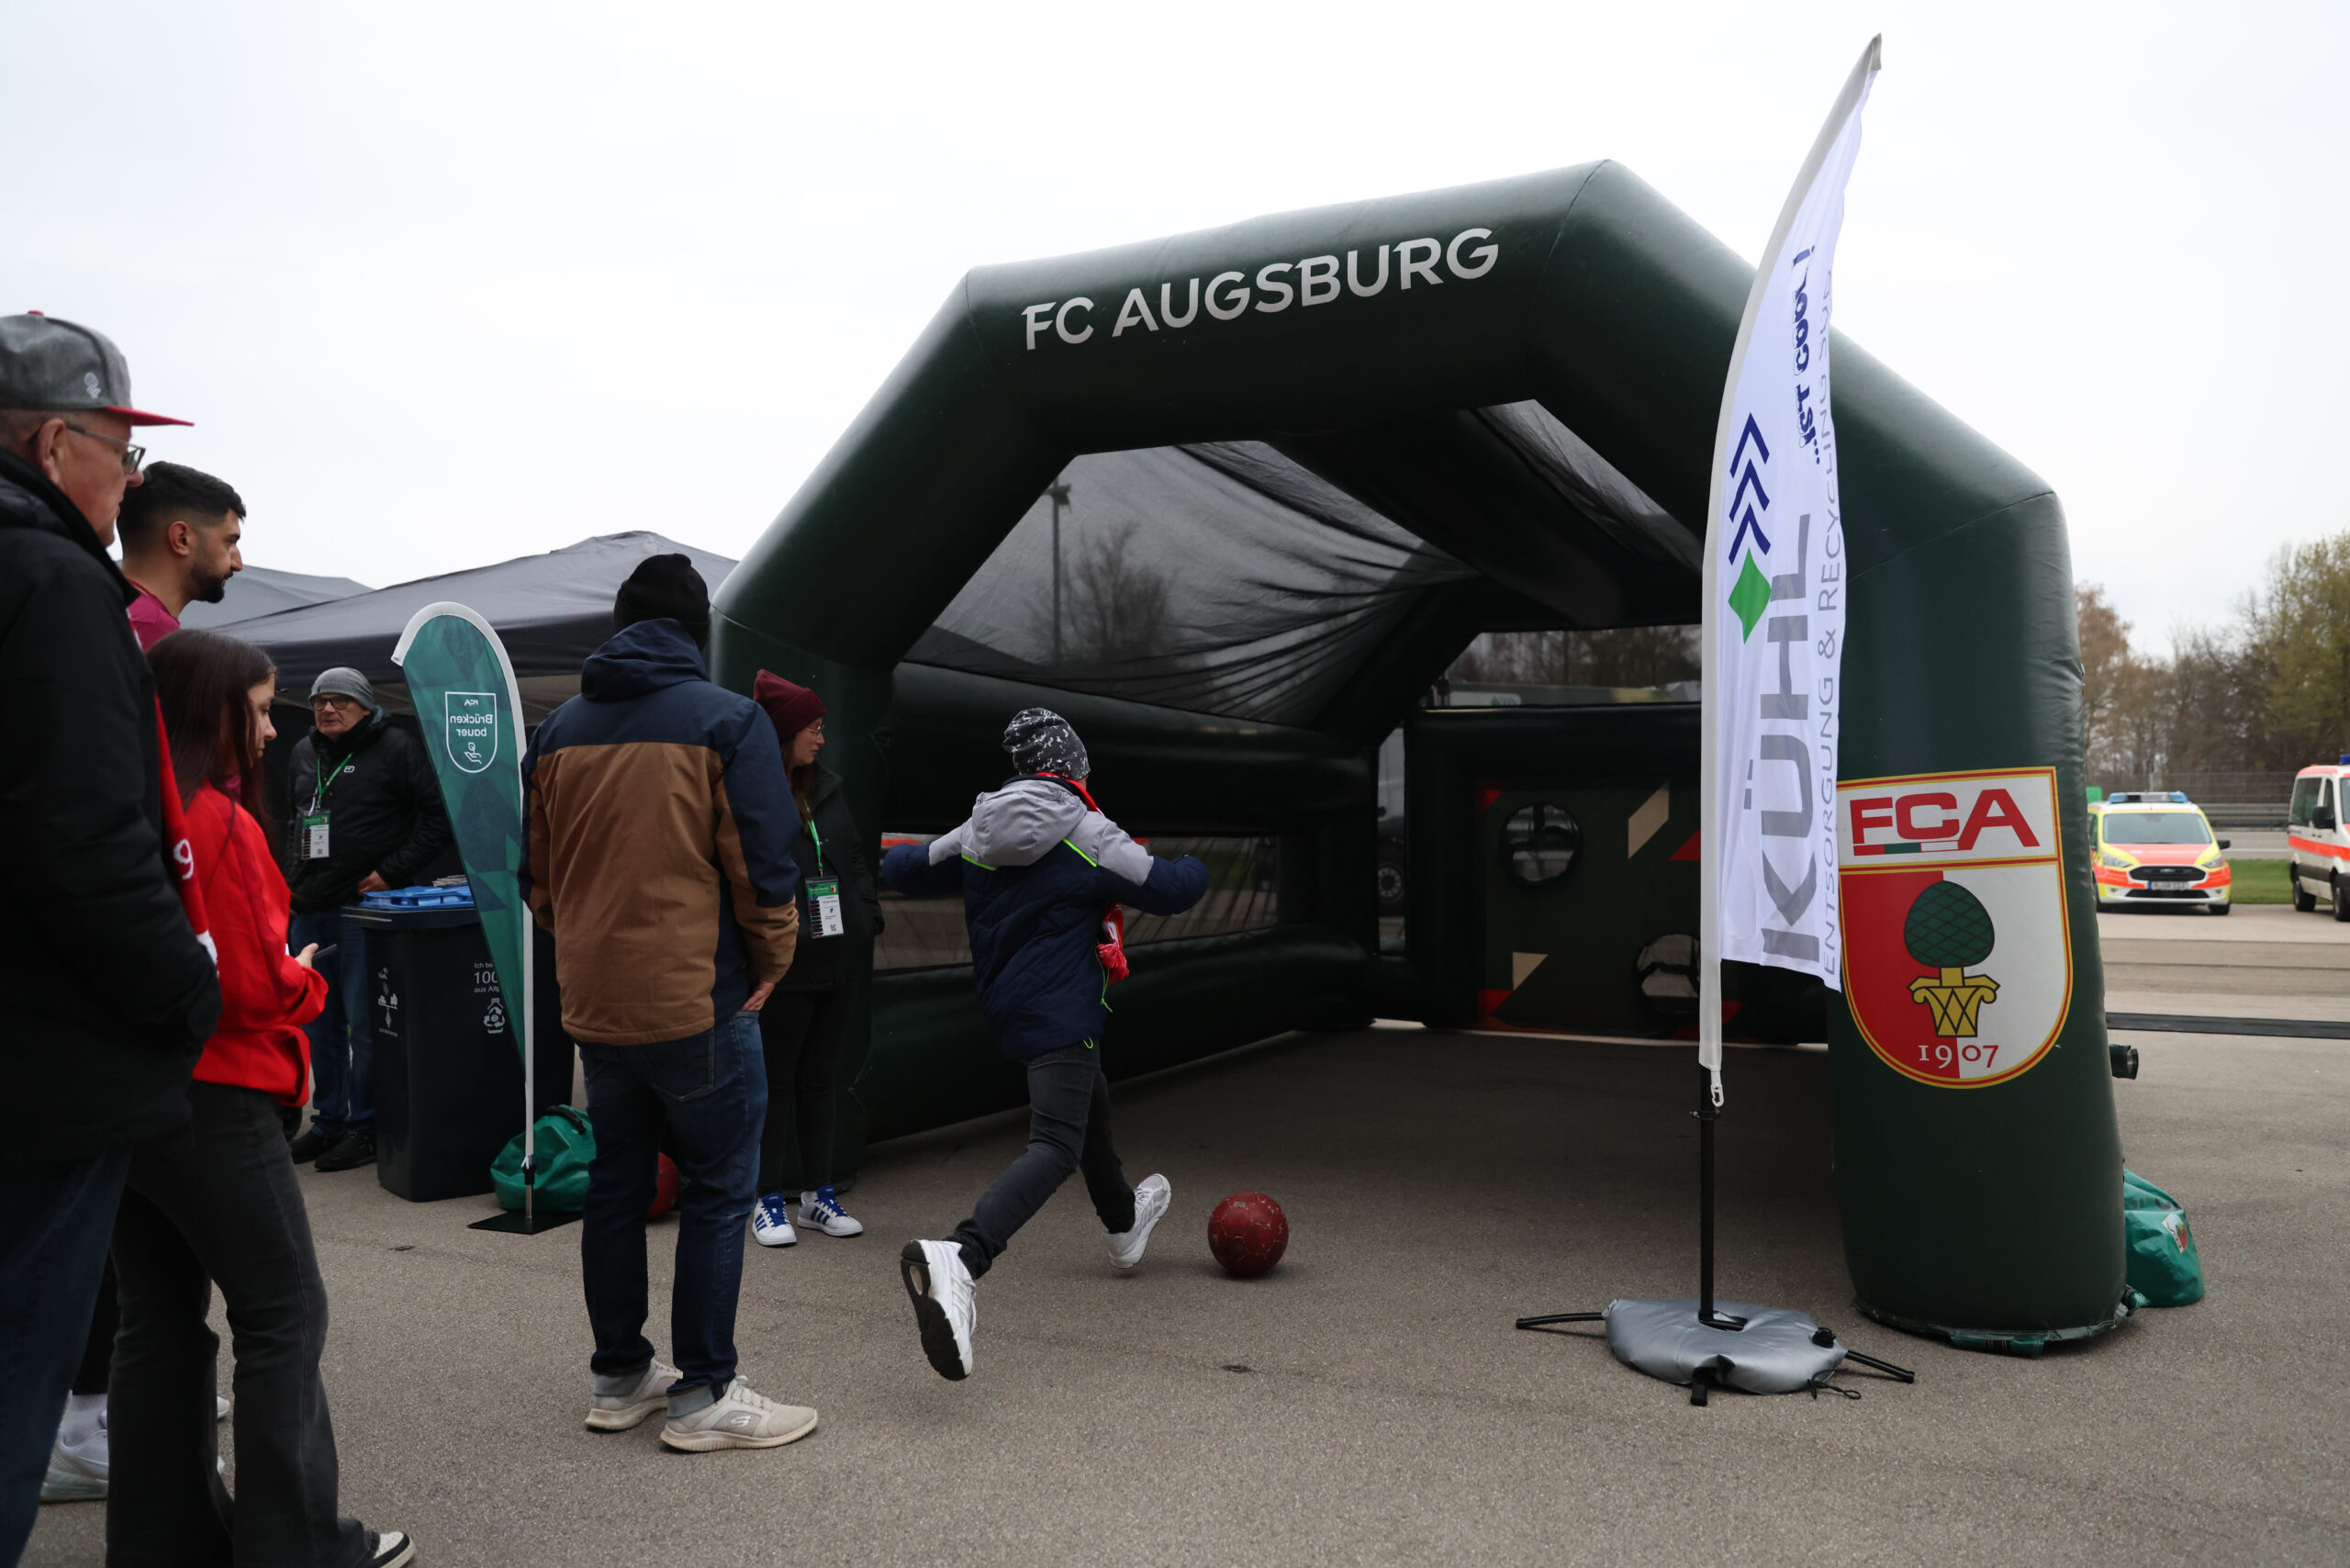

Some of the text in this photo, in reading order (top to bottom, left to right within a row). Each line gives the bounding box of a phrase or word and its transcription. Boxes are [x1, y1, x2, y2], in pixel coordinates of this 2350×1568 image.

[1021, 227, 1499, 351] FC AUGSBURG
[1818, 628, 1837, 659] &
[1743, 514, 1820, 962] KÜHL
[1818, 677, 1837, 977] ENTSORGUNG
[1849, 788, 2041, 856] FCA
[1918, 1044, 1999, 1069] 1907
